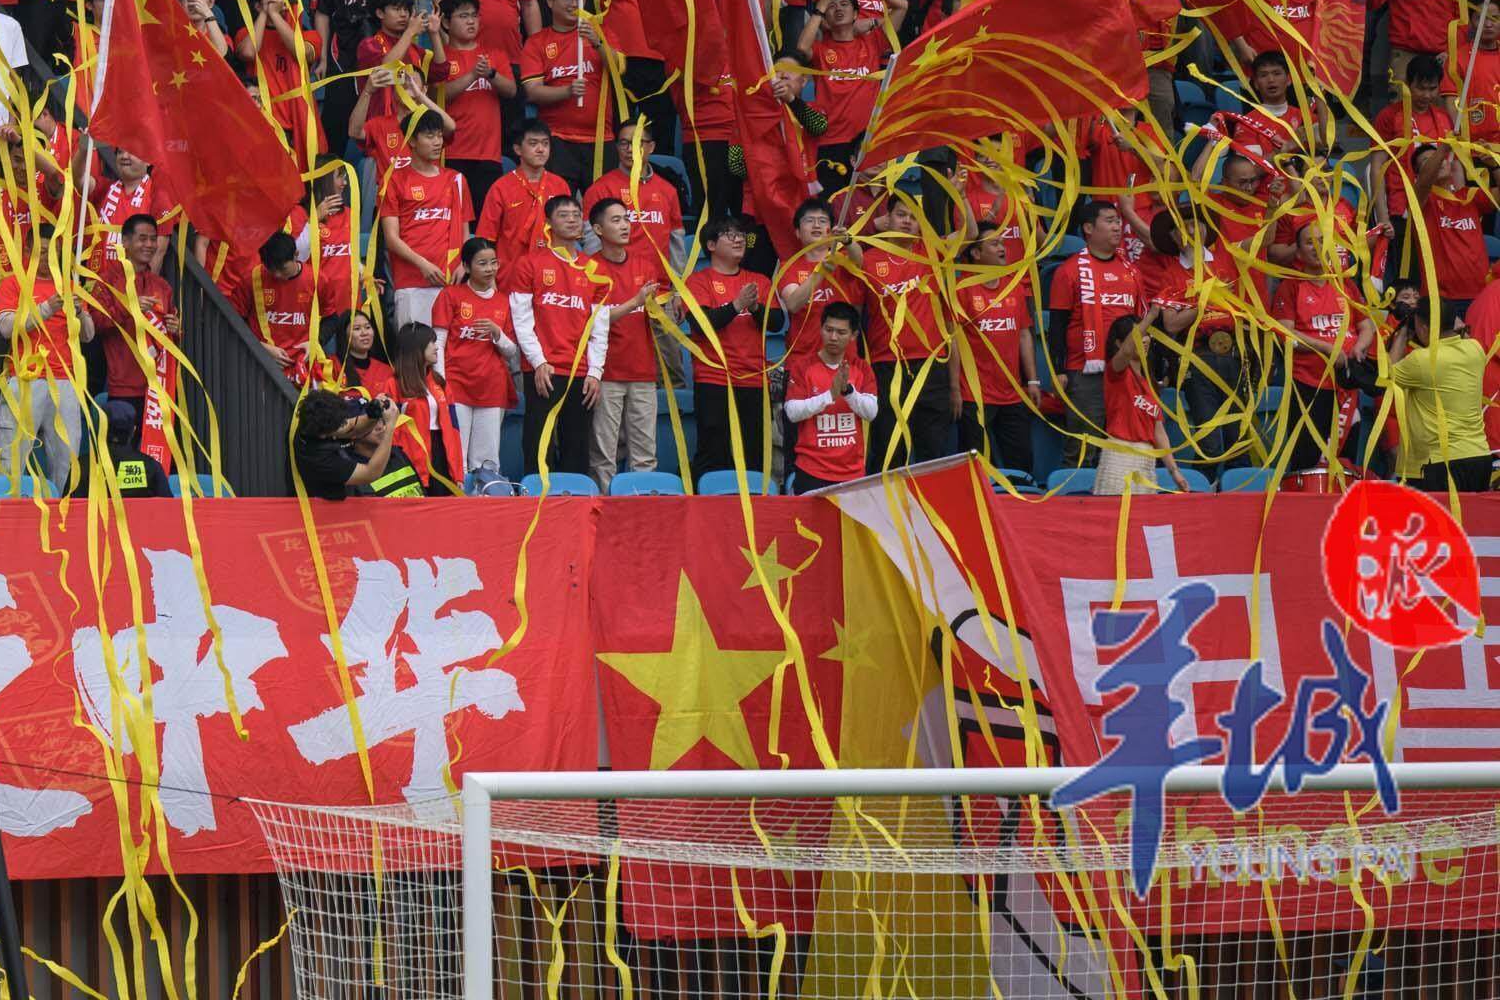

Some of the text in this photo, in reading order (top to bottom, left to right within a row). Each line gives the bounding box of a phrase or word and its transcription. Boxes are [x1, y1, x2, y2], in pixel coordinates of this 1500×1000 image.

[857, 0, 885, 12] 之队
[1273, 5, 1310, 18] 龙之队
[465, 78, 491, 91] 之队
[414, 208, 451, 221] 龙之队
[625, 209, 664, 225] 龙之队
[322, 243, 353, 257] 龙之
[542, 292, 585, 310] 龙之队
[1100, 293, 1134, 306] 龙之队
[264, 311, 306, 325] 龙之队
[979, 318, 1016, 331] 龙之队
[459, 325, 490, 340] 龙之
[816, 412, 856, 431] 中国
[819, 437, 856, 448] CHINA
[123, 476, 142, 485] QIN
[1115, 805, 1465, 889] hinese
